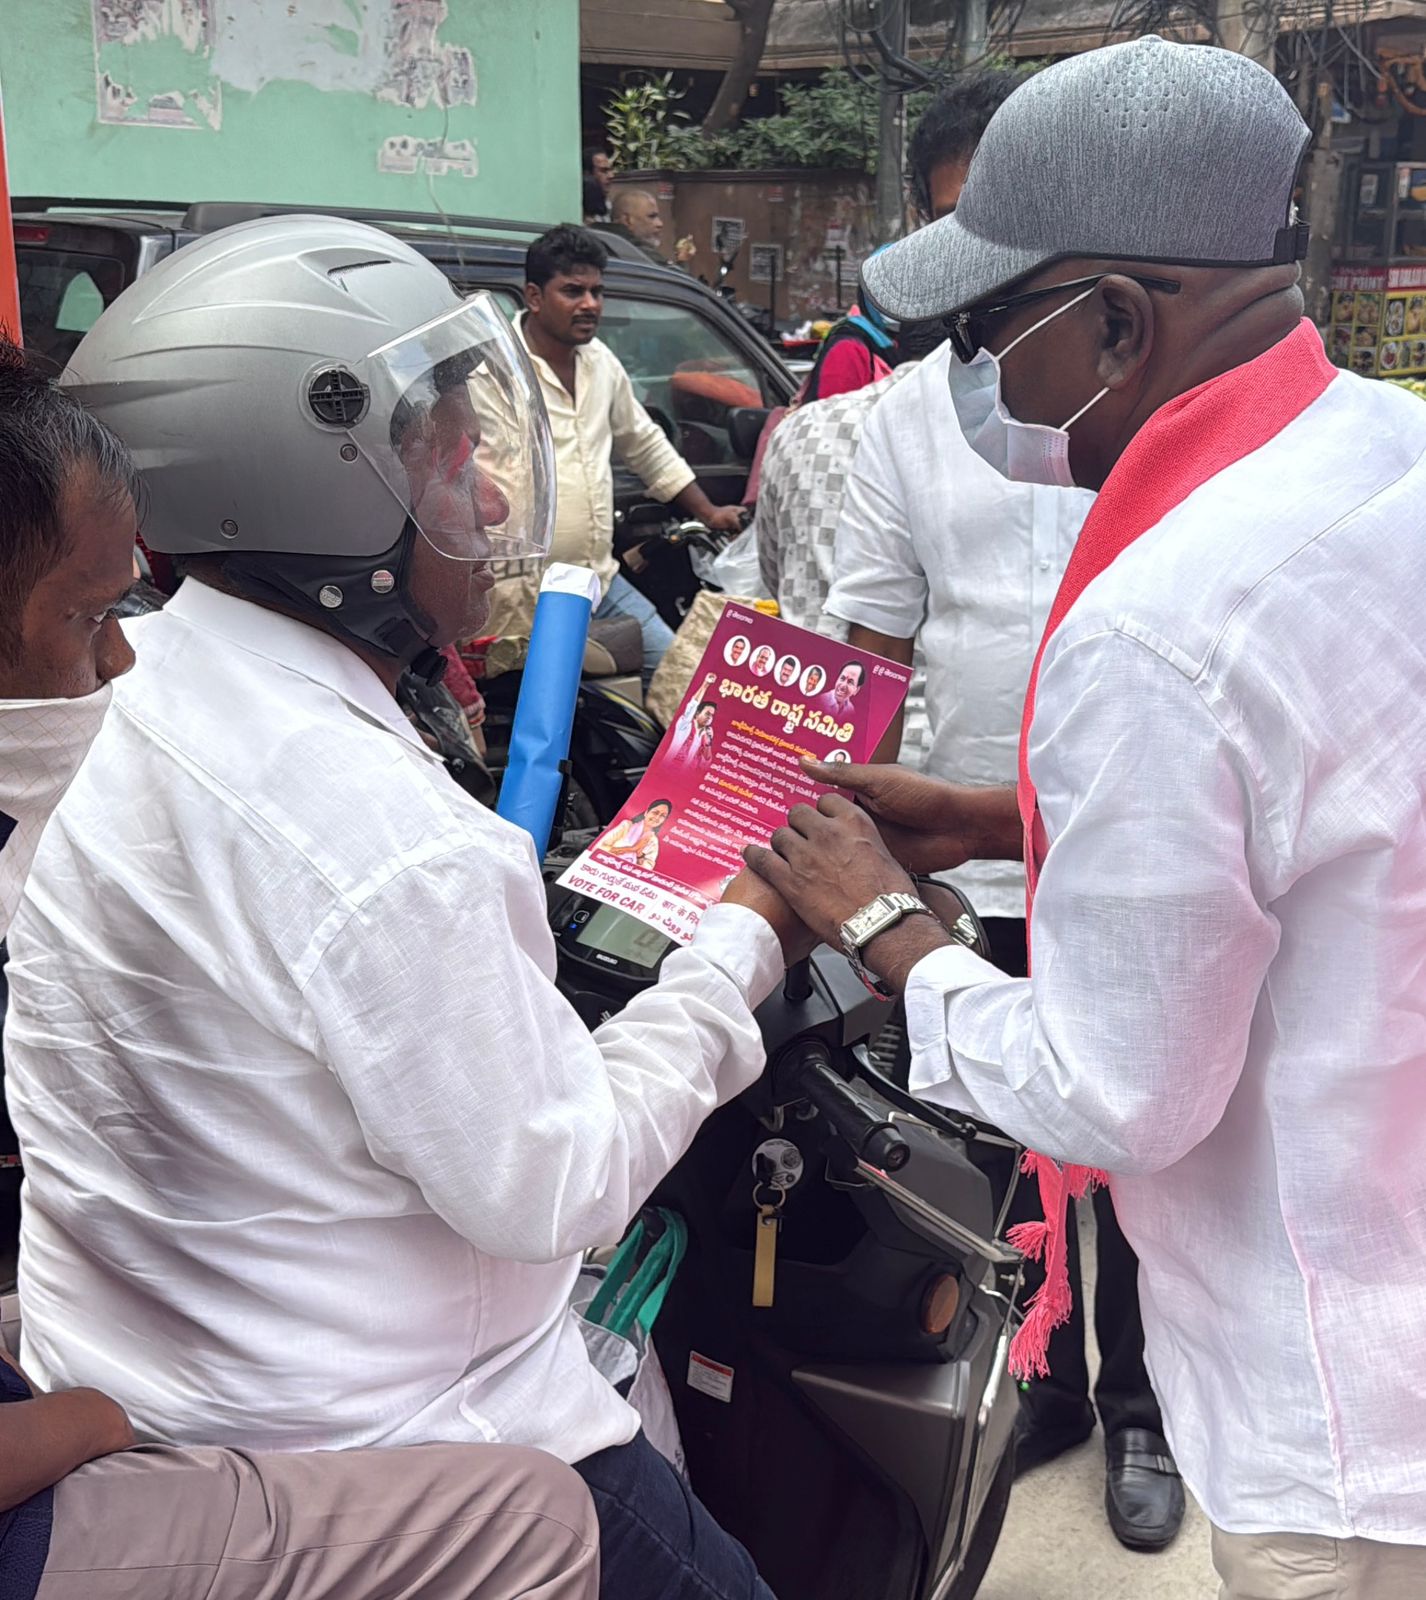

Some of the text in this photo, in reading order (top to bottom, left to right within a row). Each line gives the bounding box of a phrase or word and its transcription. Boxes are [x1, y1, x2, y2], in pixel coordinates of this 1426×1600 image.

[718, 678, 772, 710] భారత
[770, 697, 805, 735] రాష్ట్ర
[803, 711, 855, 743] సమితి
[568, 876, 646, 914] VOTE FOR CAR
